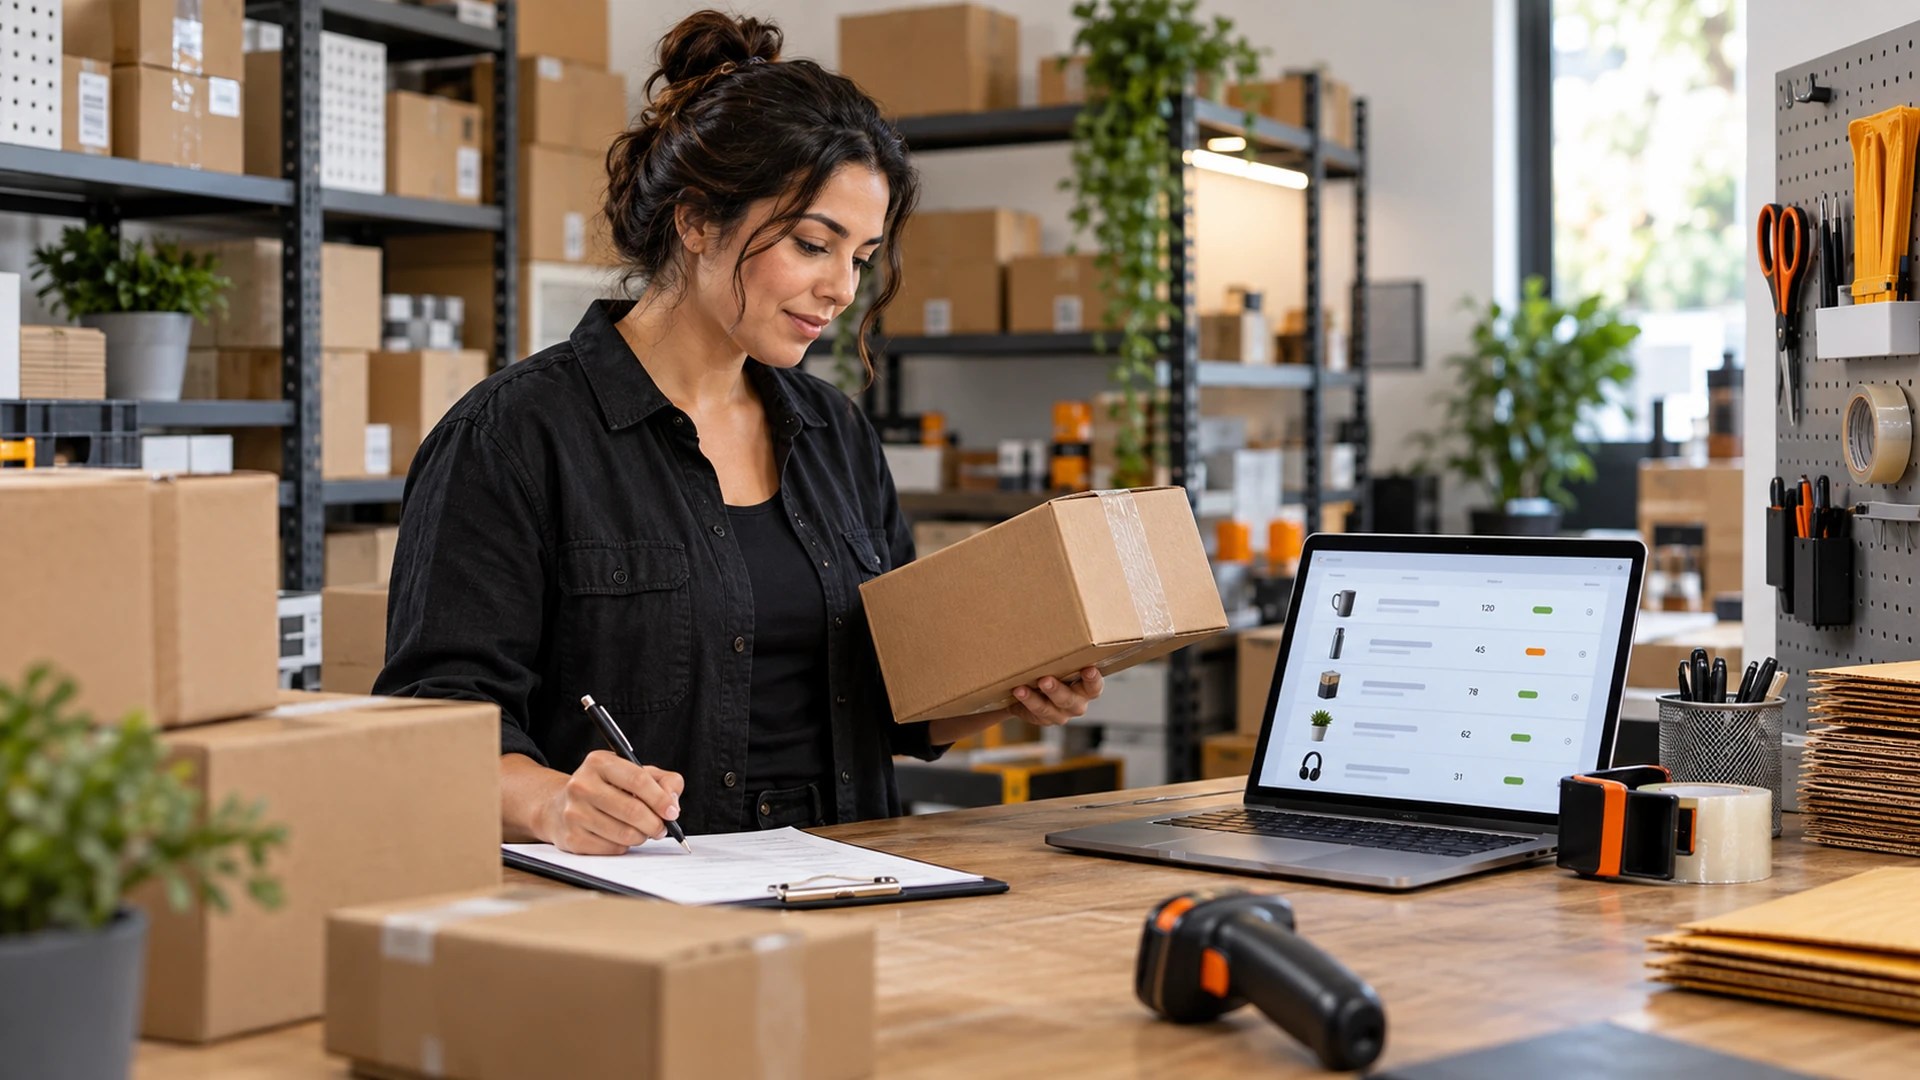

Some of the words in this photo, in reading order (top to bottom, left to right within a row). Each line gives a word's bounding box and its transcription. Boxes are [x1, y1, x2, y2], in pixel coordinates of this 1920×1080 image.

[1481, 604, 1495, 613] 120
[1474, 645, 1486, 654] 45
[1468, 687, 1479, 696] 78
[1460, 730, 1472, 739] 62
[1453, 772, 1463, 781] 31
